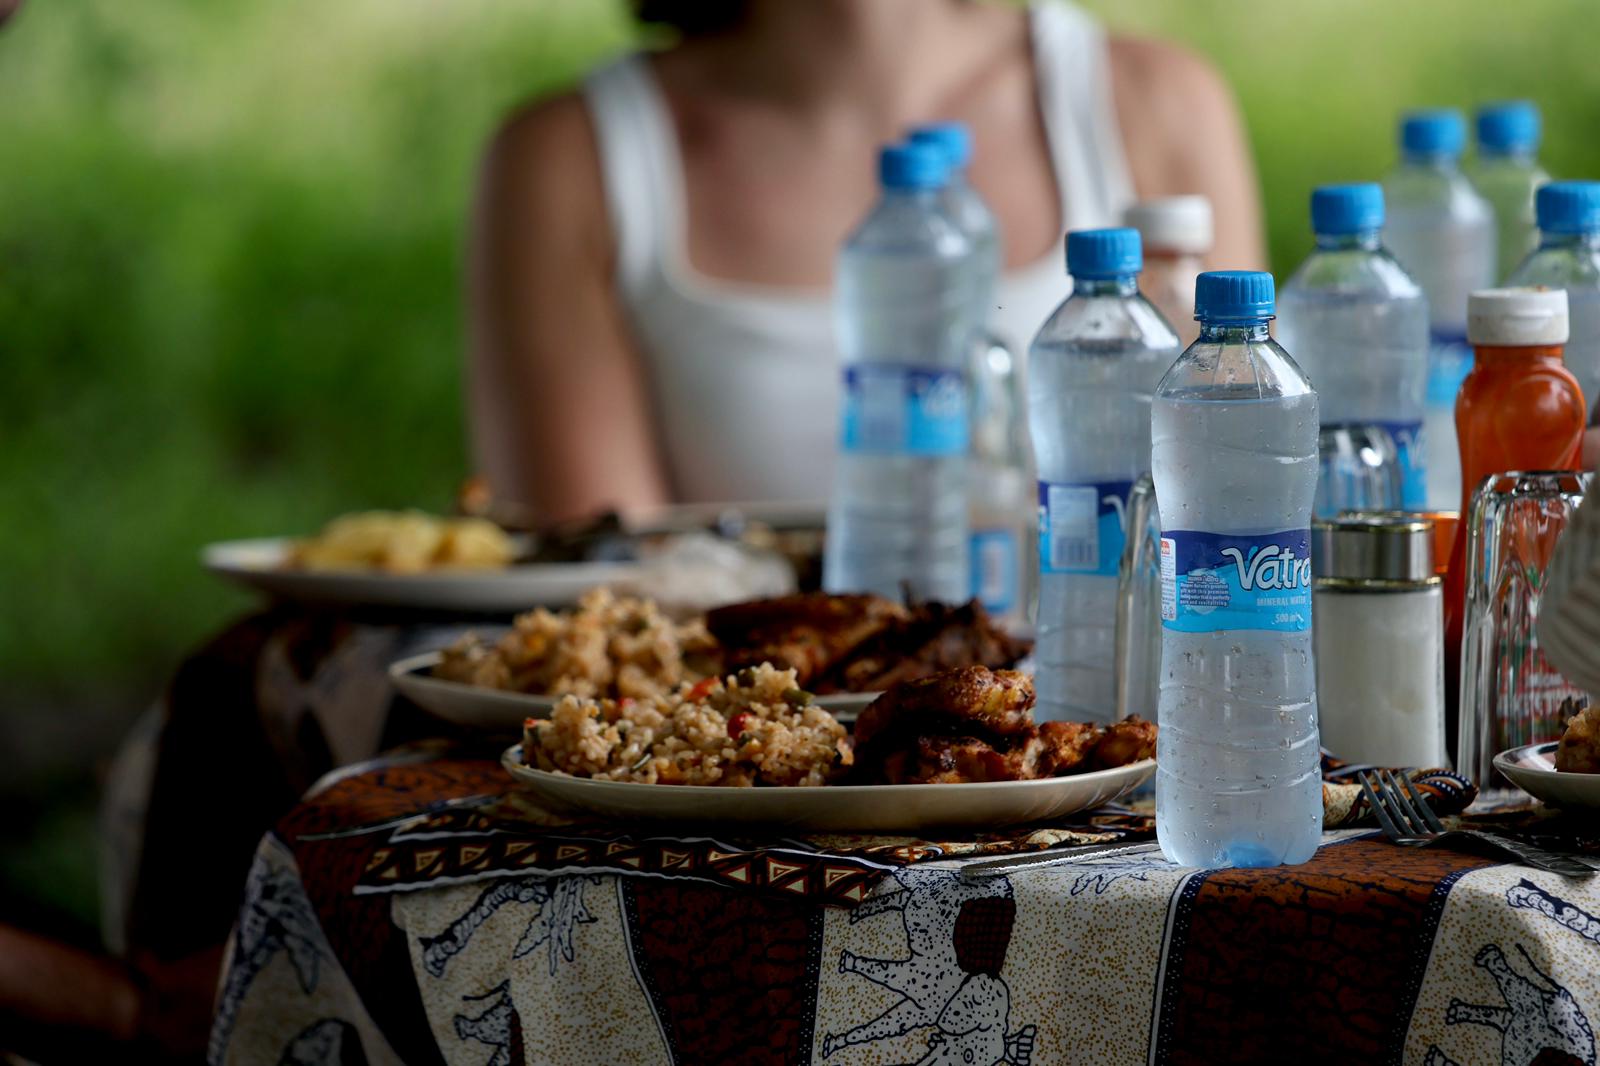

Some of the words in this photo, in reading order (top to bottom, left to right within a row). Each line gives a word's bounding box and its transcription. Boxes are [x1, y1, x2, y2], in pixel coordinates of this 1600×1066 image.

[1221, 544, 1311, 590] Vatra
[1256, 597, 1289, 606] MINERAL
[1275, 613, 1289, 623] 500
